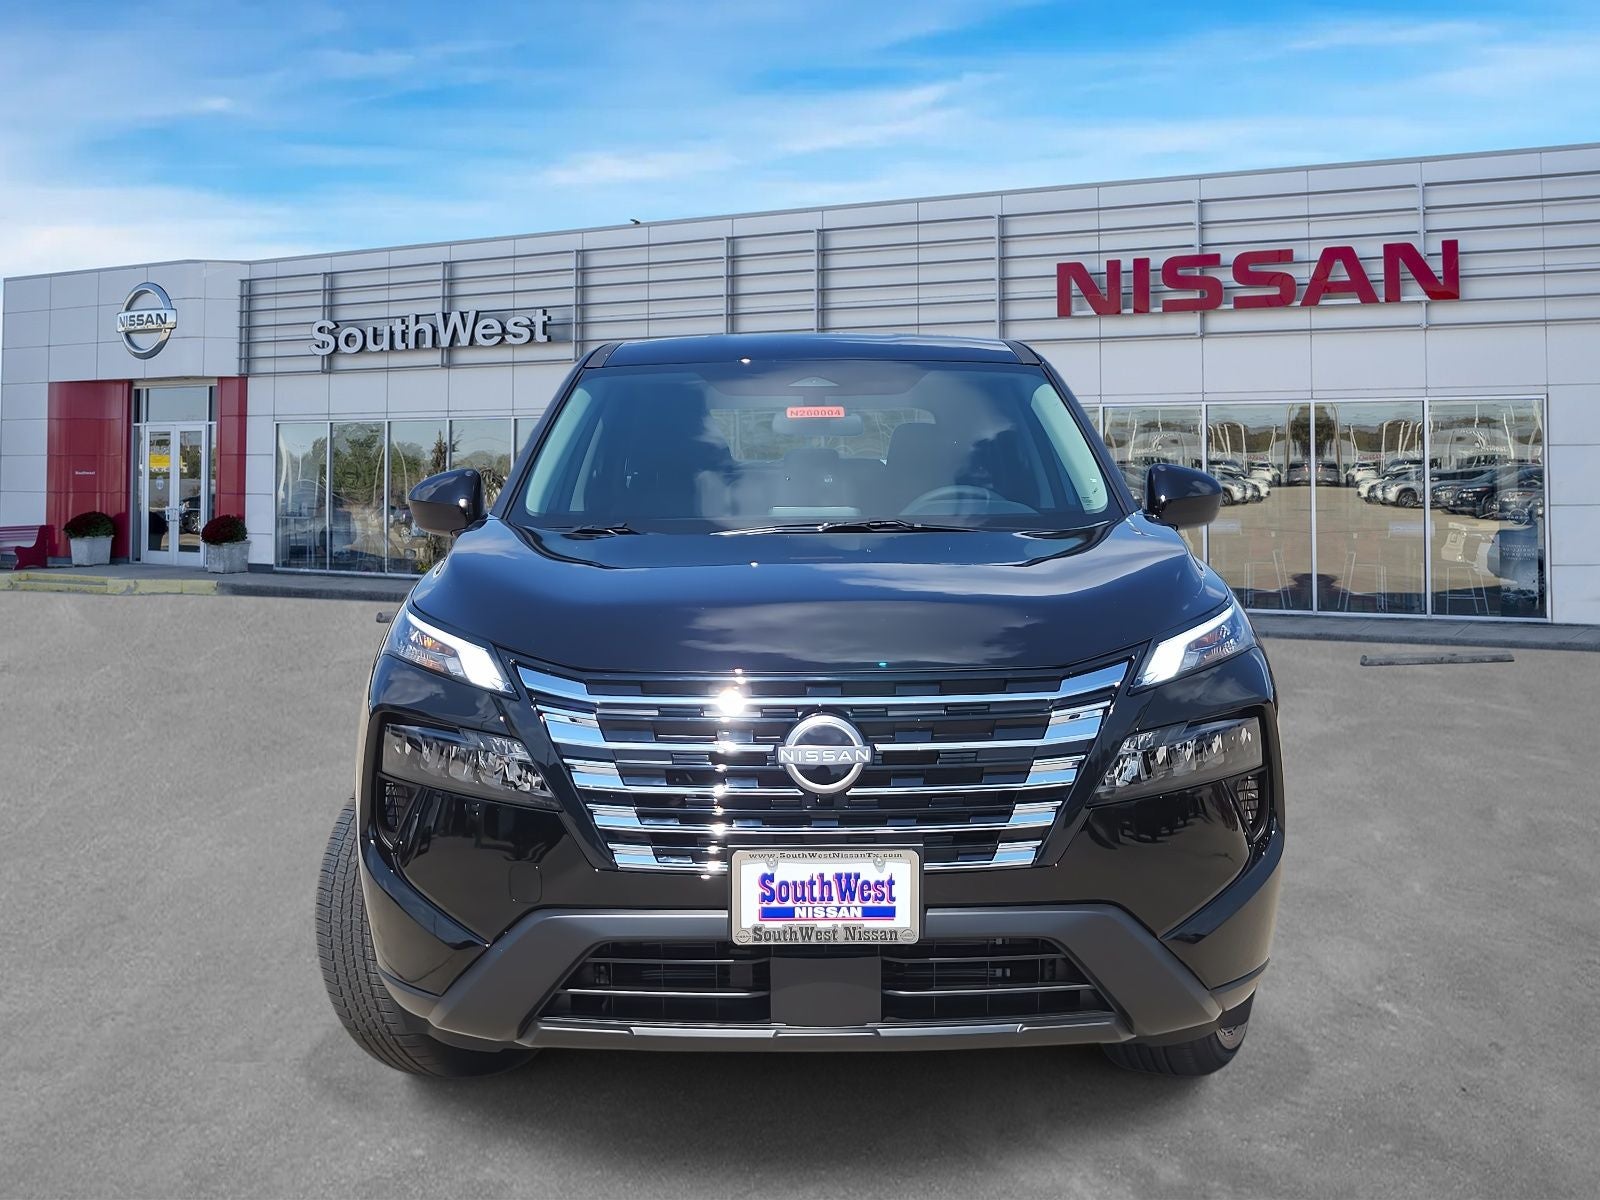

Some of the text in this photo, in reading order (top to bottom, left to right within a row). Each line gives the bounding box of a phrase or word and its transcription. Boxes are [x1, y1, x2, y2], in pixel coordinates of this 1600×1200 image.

[1057, 239, 1460, 318] NISSAN
[119, 312, 167, 327] NISSAN
[310, 308, 552, 355] SouthWest
[780, 749, 869, 762] NISSAN
[759, 872, 896, 904] SouthWest
[794, 906, 862, 918] NISSAN
[752, 926, 898, 942] SouthWest Nissan
